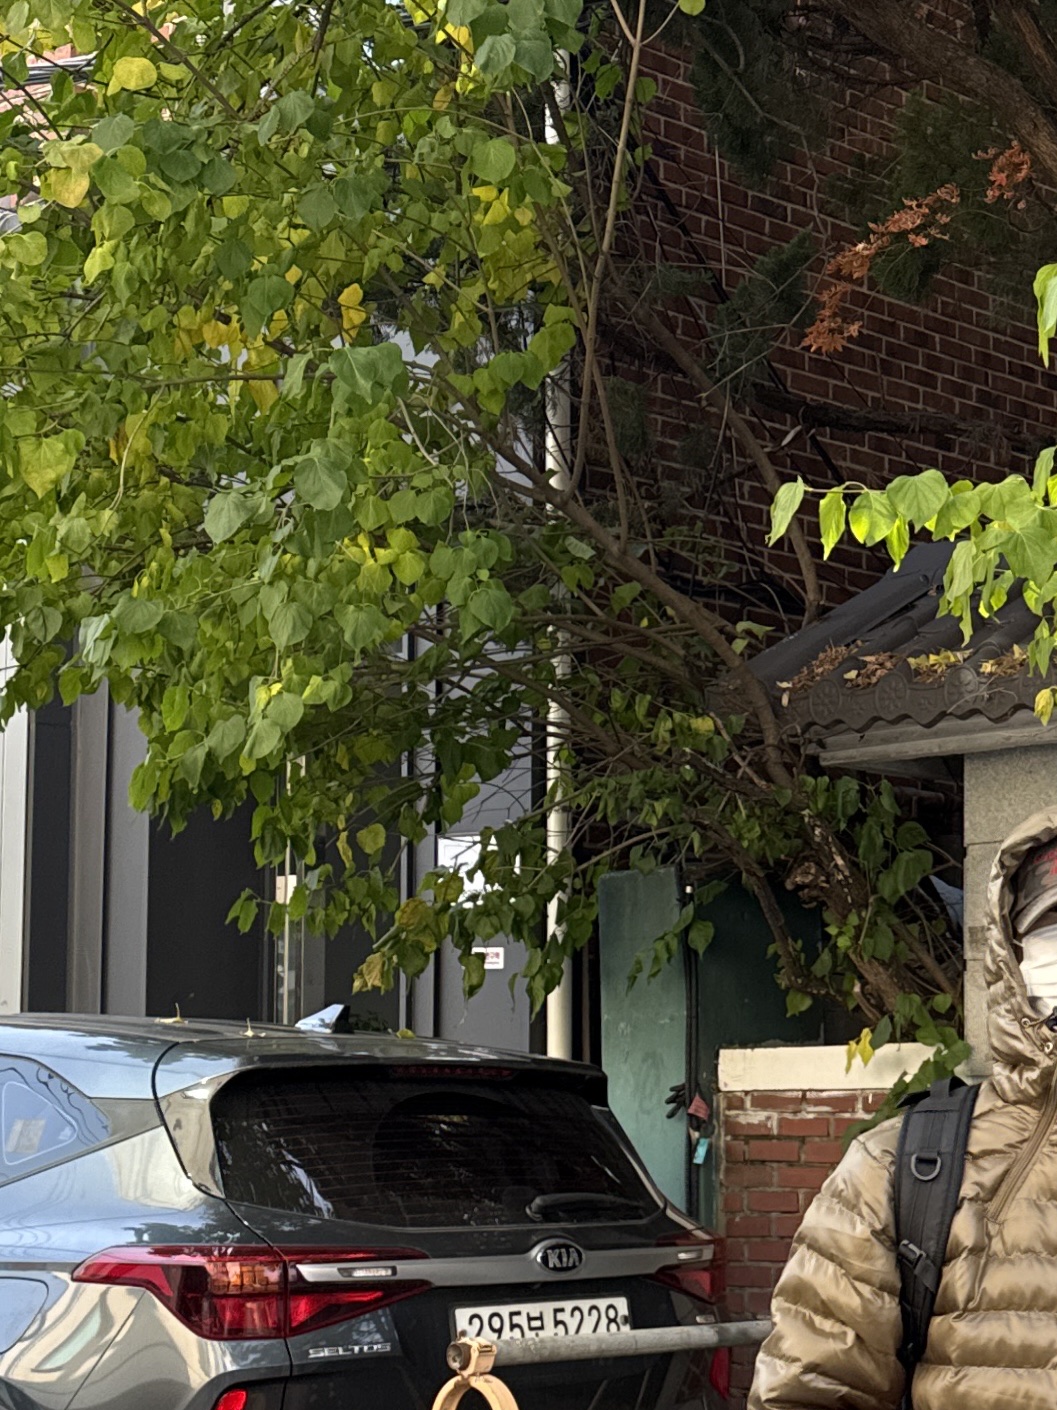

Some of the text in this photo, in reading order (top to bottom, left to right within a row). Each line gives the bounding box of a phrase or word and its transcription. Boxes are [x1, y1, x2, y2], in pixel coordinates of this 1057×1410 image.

[547, 1248, 580, 1268] KIA
[553, 1303, 621, 1336] 5228
[308, 1342, 392, 1359] SELTOS
